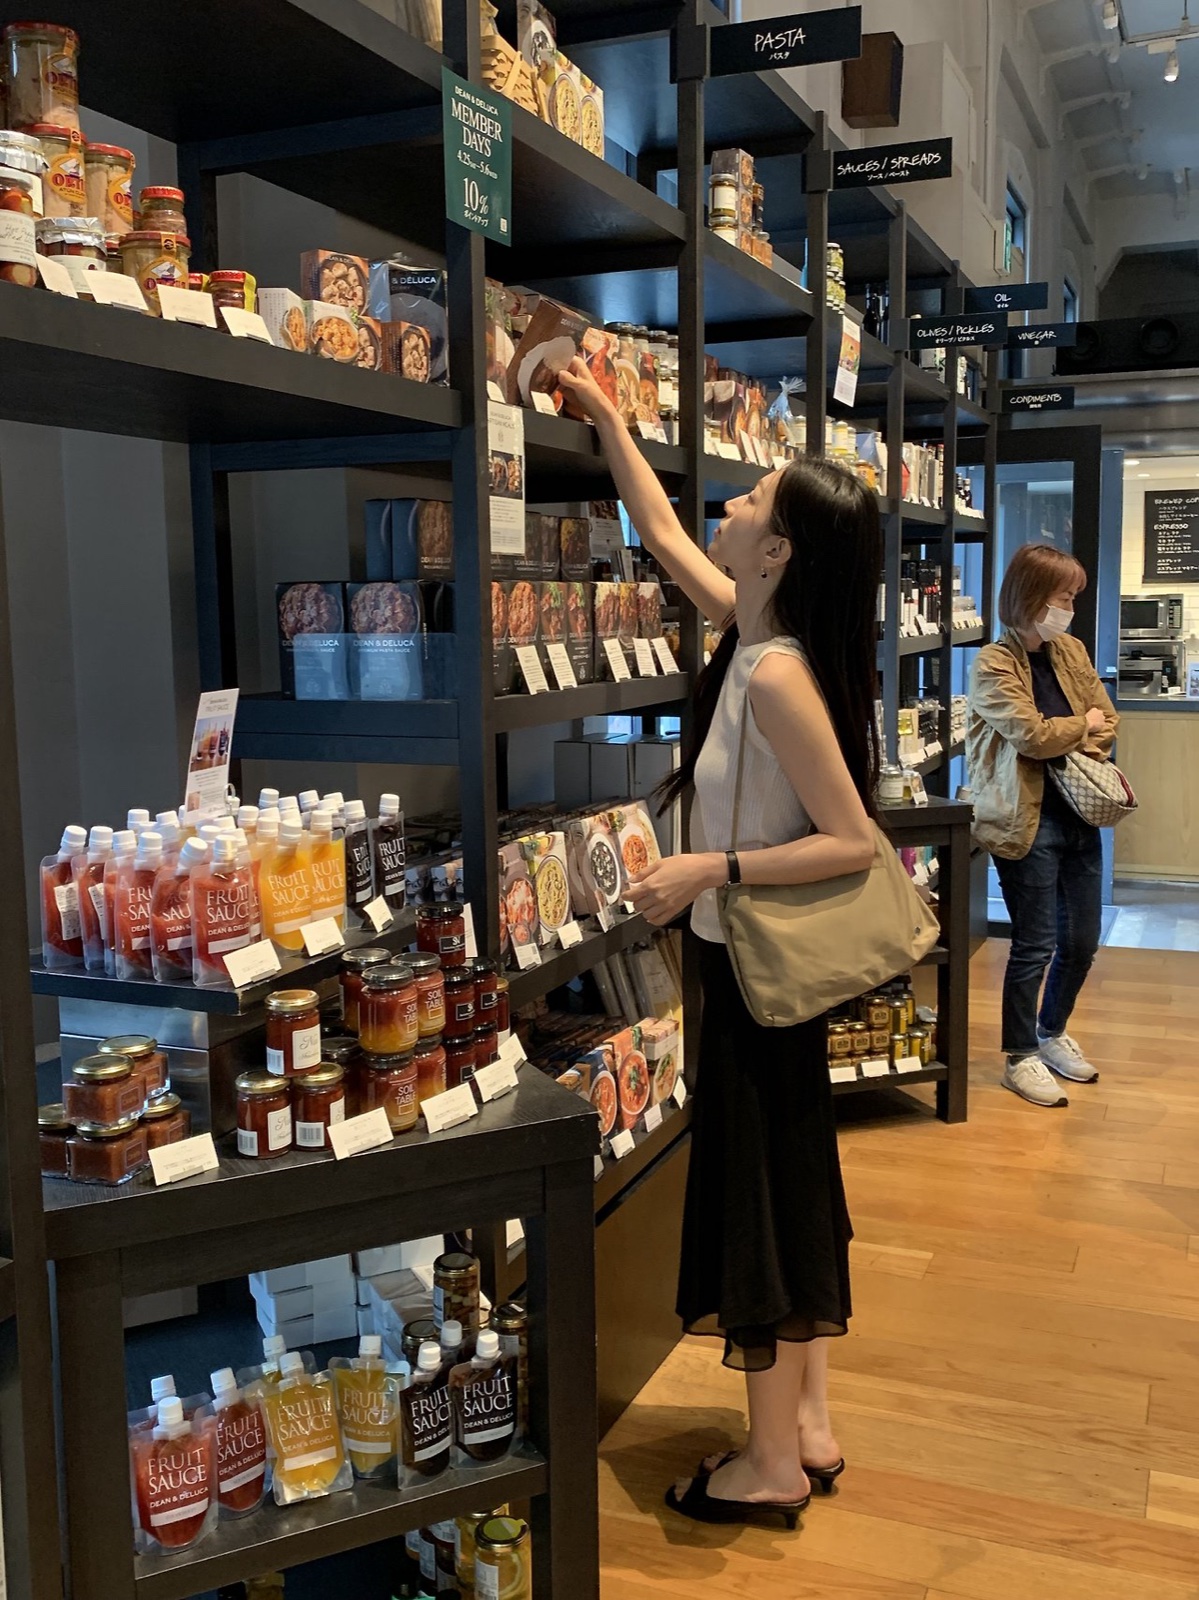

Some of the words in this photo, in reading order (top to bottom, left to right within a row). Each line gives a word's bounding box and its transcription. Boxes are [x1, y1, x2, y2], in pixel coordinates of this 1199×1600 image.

[754, 27, 807, 52] PASTA
[768, 51, 790, 60] パスタ
[454, 85, 471, 101] DEAN
[475, 97, 499, 116] DELUCA
[451, 97, 503, 142] MEMBER
[462, 125, 491, 157] DAYS
[837, 160, 881, 176] SAUCES
[890, 152, 941, 169] SPREADS
[463, 178, 489, 215] 10%
[994, 293, 1012, 303] OIL
[916, 327, 947, 338] OLIVES
[956, 323, 995, 335] PICKLES
[1018, 330, 1057, 341] VINEGAR
[1010, 393, 1062, 404] CONDIMENTS
[378, 837, 405, 857] FRUIT
[268, 869, 306, 891] FRUIT
[206, 883, 249, 906] FRUIT
[272, 885, 310, 906] SAUCE
[208, 926, 227, 936] DEAN
[395, 1091, 416, 1105] TABLE
[398, 1084, 415, 1096] SOIL
[343, 1388, 391, 1408] FRUIT
[463, 1375, 511, 1400] FRUIT
[278, 1396, 325, 1422] FRUIT
[411, 1384, 449, 1418] FRUIT
[463, 1393, 513, 1418] SAUCE
[342, 1404, 389, 1426] SAUCE
[464, 1419, 483, 1429] DEAN
[490, 1412, 514, 1423] DELUCA
[215, 1411, 259, 1446] FRUIT
[280, 1413, 332, 1441] SAUCE
[217, 1428, 264, 1464] SAUCE
[414, 1434, 432, 1446] DEAN
[148, 1447, 204, 1476] FRUIT
[219, 1463, 237, 1476] DEAN
[149, 1464, 207, 1495] SAUCE
[150, 1496, 171, 1509] DEAN
[179, 1486, 208, 1500] DELUCA
